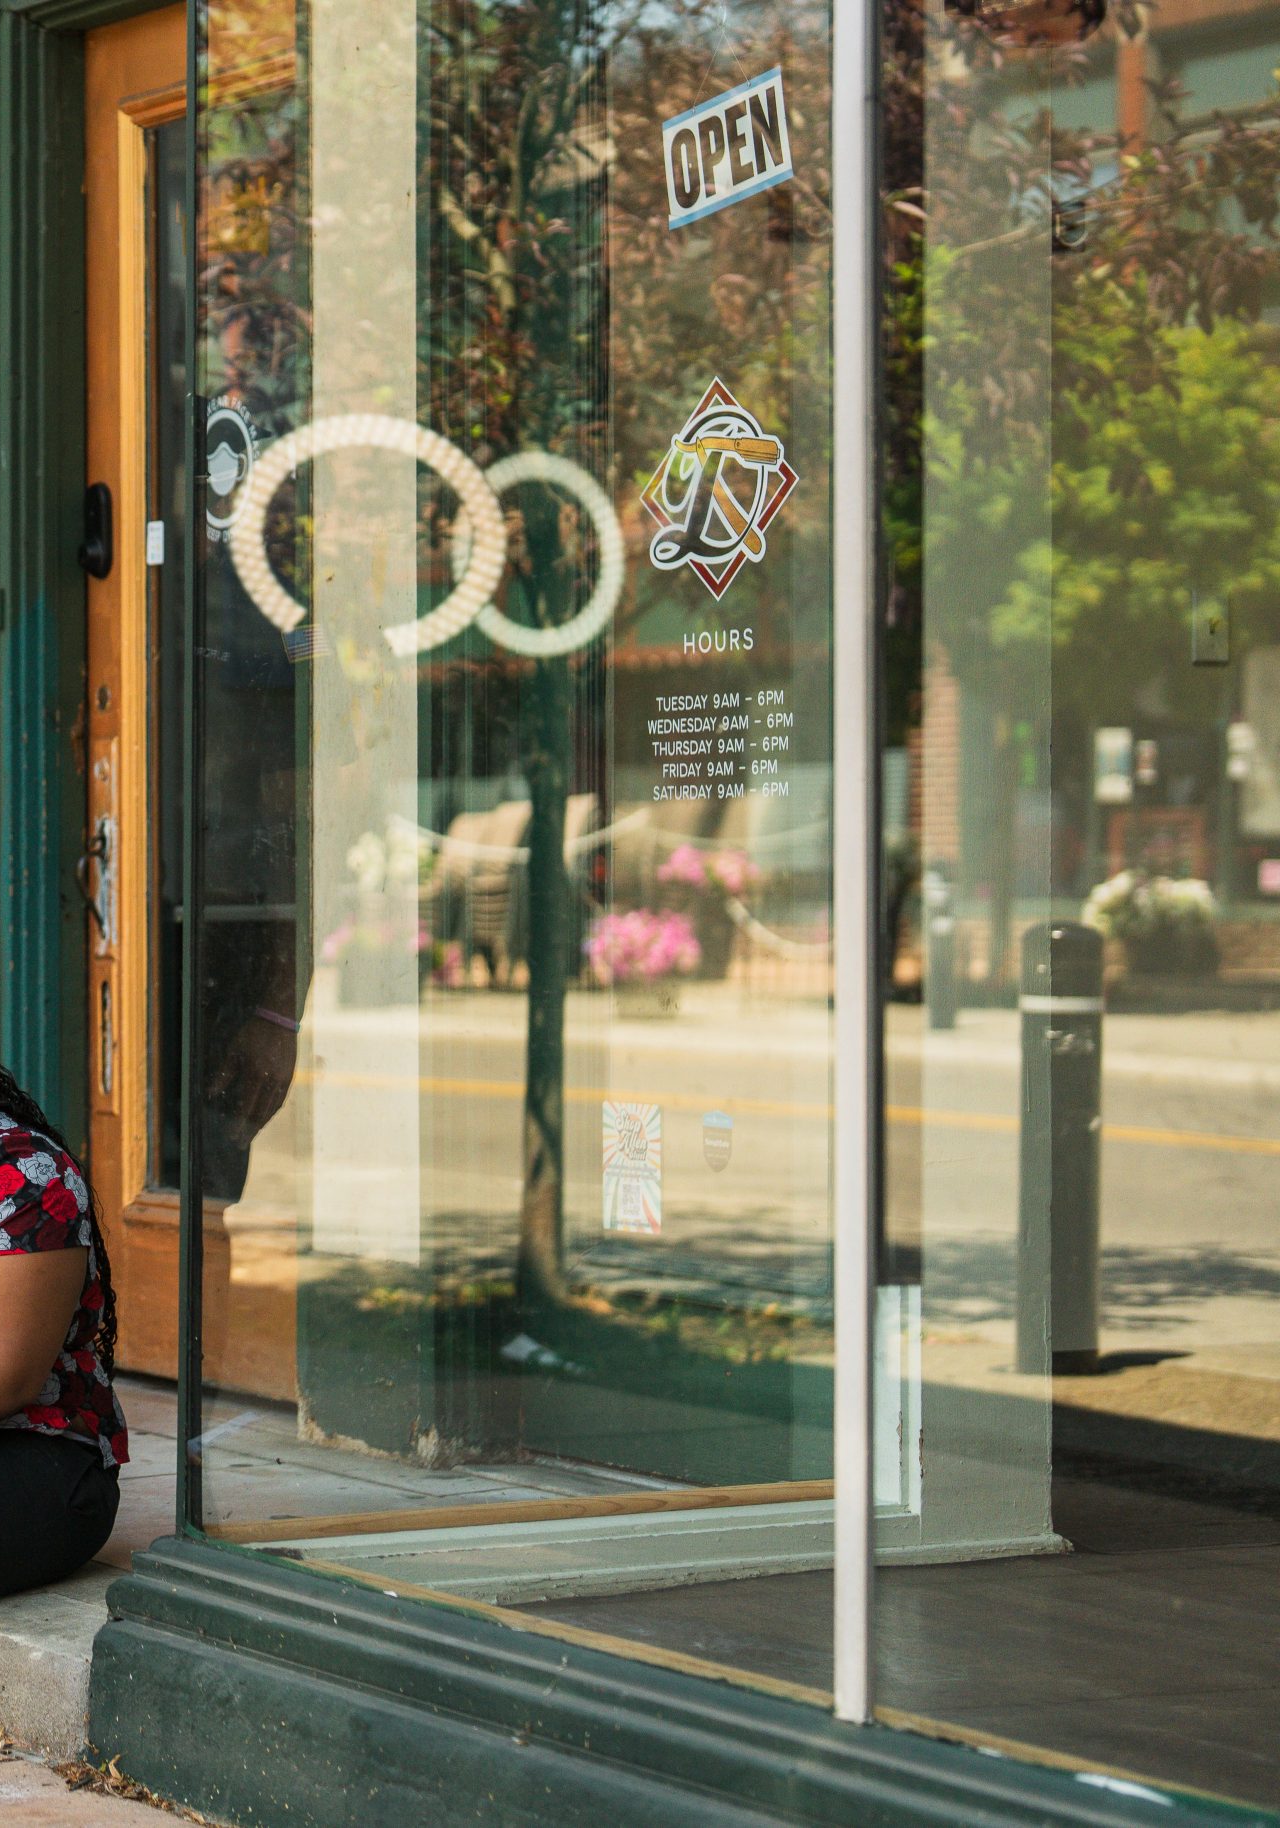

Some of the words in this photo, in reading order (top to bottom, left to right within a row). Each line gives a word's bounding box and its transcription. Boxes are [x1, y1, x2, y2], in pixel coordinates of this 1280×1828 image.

[671, 85, 784, 209] OPEN
[683, 628, 754, 655] HOURS
[656, 694, 708, 712] TUESDAY
[713, 692, 740, 709] 9AM
[757, 690, 784, 706] 6PM
[647, 717, 717, 735] WEDNESDAY
[722, 715, 749, 731] 9AM
[767, 712, 794, 728] 6PM
[652, 739, 713, 756] THURSDAY
[718, 738, 744, 754] 9AM
[762, 736, 789, 751] 6PM
[662, 762, 702, 778] FRIDAY
[707, 761, 734, 777] 9AM
[751, 759, 778, 775] 6PM
[653, 784, 712, 801] SATURDAY
[717, 783, 744, 799] 9AM
[762, 782, 789, 797] 6PM
[615, 1108, 643, 1134] Shop
[618, 1131, 649, 1153] Allen
